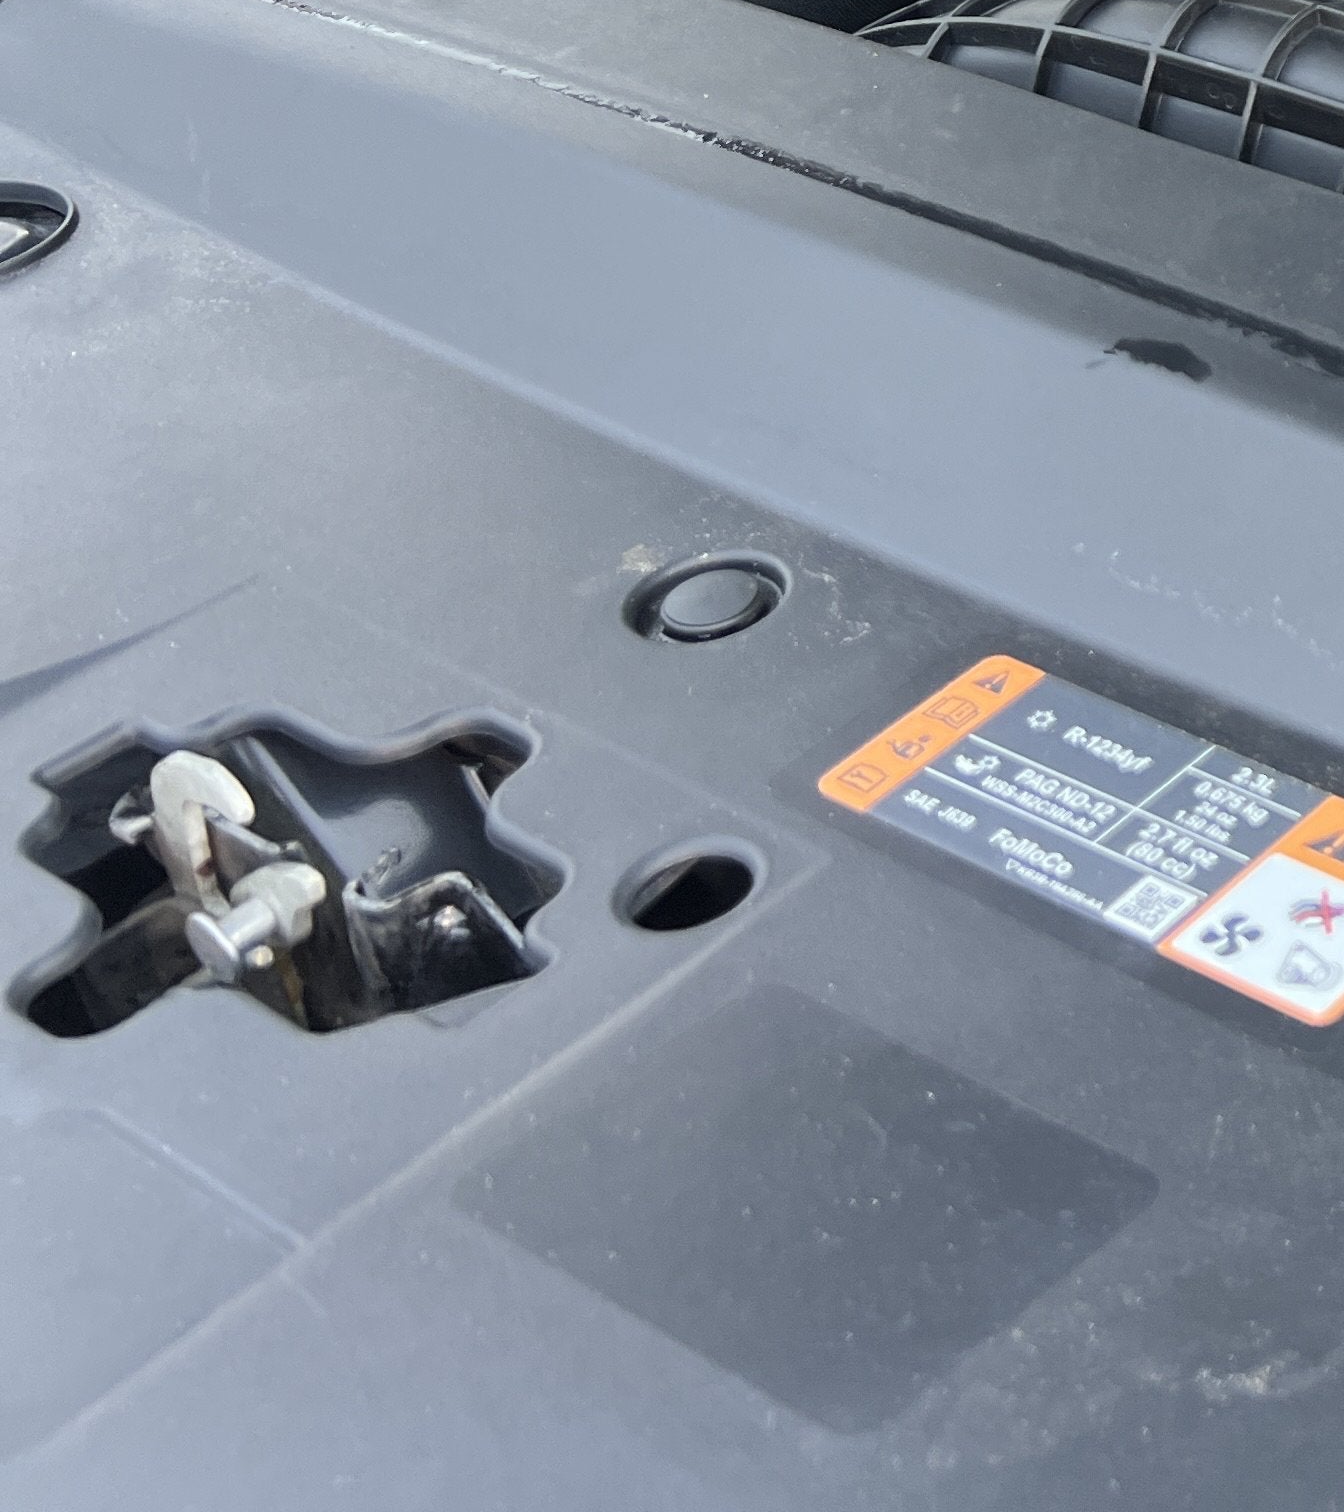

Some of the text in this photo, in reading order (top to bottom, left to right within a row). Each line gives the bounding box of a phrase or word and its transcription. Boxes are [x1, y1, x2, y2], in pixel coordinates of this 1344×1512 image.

[1063, 726, 1154, 773] R-1234yf
[1015, 768, 1117, 824] PAG ND-12
[1194, 781, 1270, 828] 0.675 kg
[1231, 767, 1275, 797] 2.3L
[904, 789, 977, 831] SAE J639
[988, 828, 1074, 878] FoMoCo
[1125, 840, 1198, 882] (80 cc)
[1139, 823, 1177, 845] 2.7
[1190, 847, 1219, 871] oz
